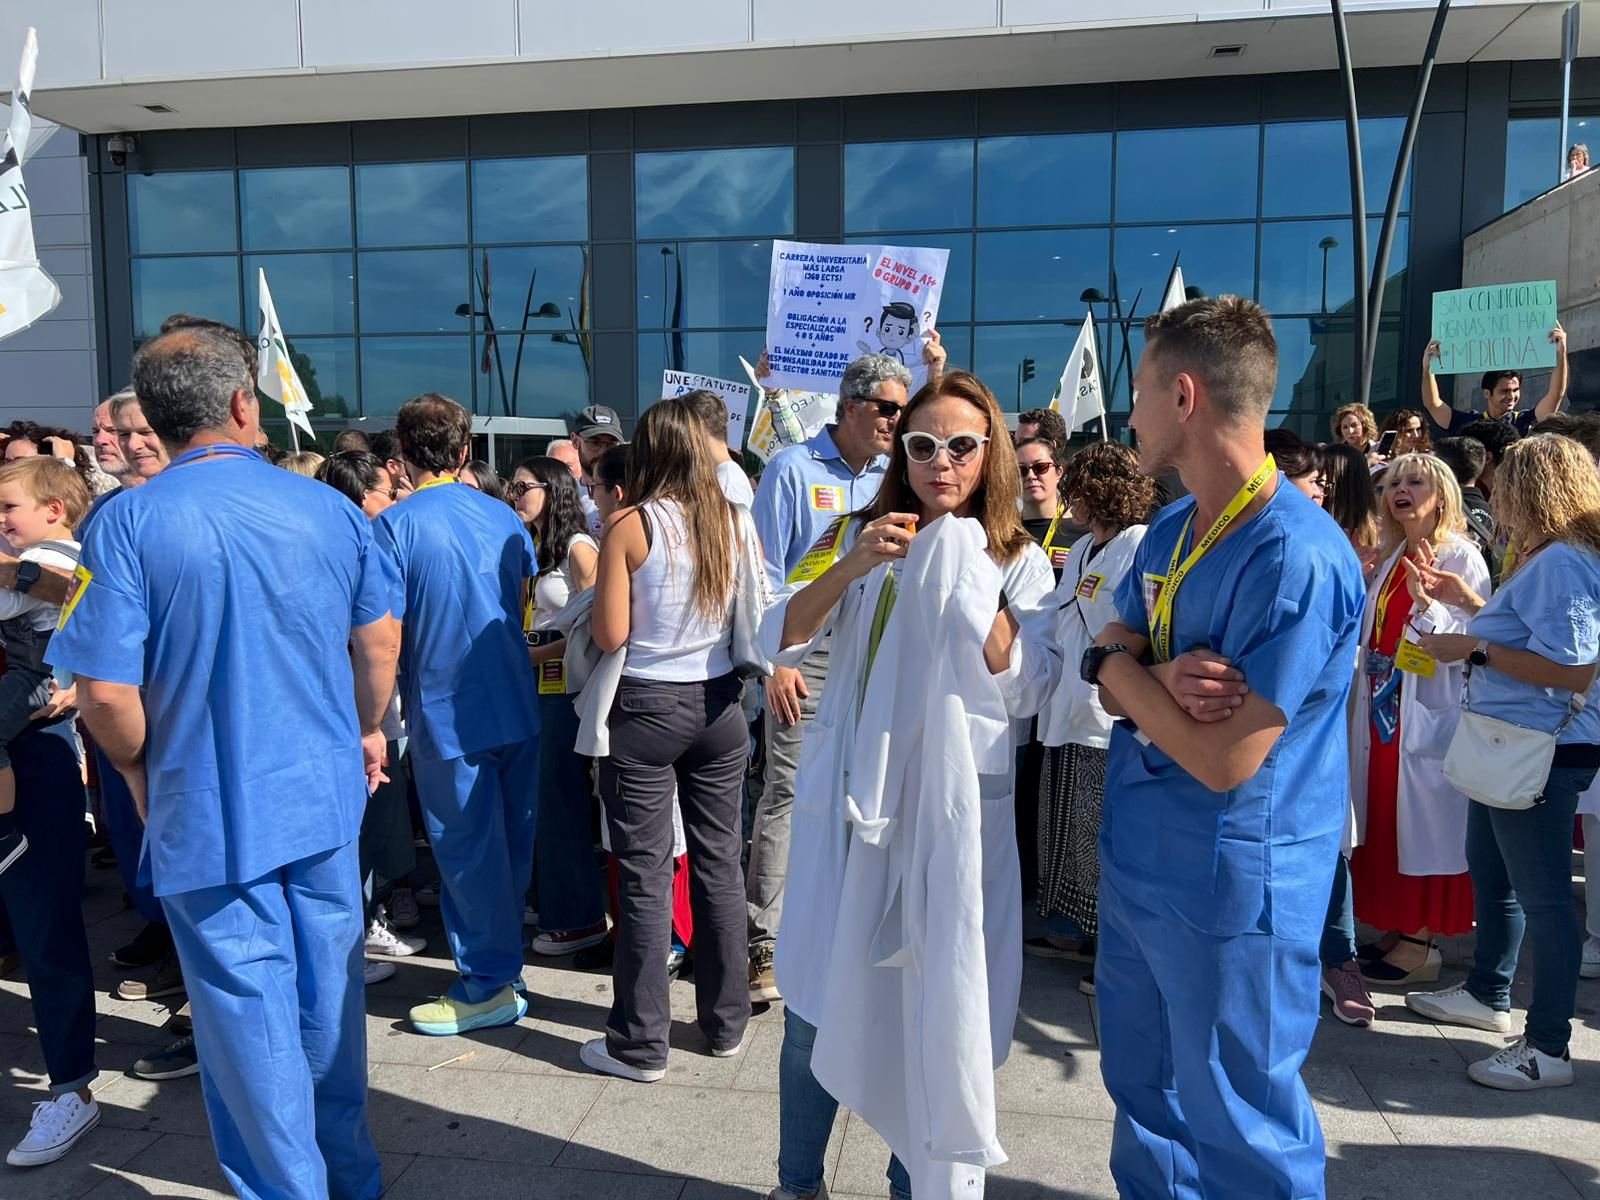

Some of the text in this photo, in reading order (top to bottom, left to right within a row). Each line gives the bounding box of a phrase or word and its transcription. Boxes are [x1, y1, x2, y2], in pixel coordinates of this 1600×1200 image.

[780, 252, 867, 264] CARRERA UNIVERSITARIA
[803, 263, 845, 273] MÁS LARGA
[880, 256, 891, 268] EL
[893, 262, 918, 280] NIVEL
[821, 274, 842, 282] ECTS)
[883, 272, 912, 290] GRUPO
[788, 286, 804, 296] AÑO
[806, 289, 843, 299] OPOSICIÓN
[1439, 286, 1552, 316] SIN CONDICIONES
[788, 313, 828, 323] OBLIGACIÓN
[838, 317, 846, 325] LA
[1439, 317, 1485, 339] DIGNAS
[1519, 311, 1546, 331] HAY
[786, 322, 846, 334] ESPECIALIZACIÓN
[815, 332, 834, 341] AÑOS
[784, 346, 812, 357] MÁXIMO
[770, 363, 843, 378] DEL SECTOR SANITARI
[730, 413, 741, 421] DE
